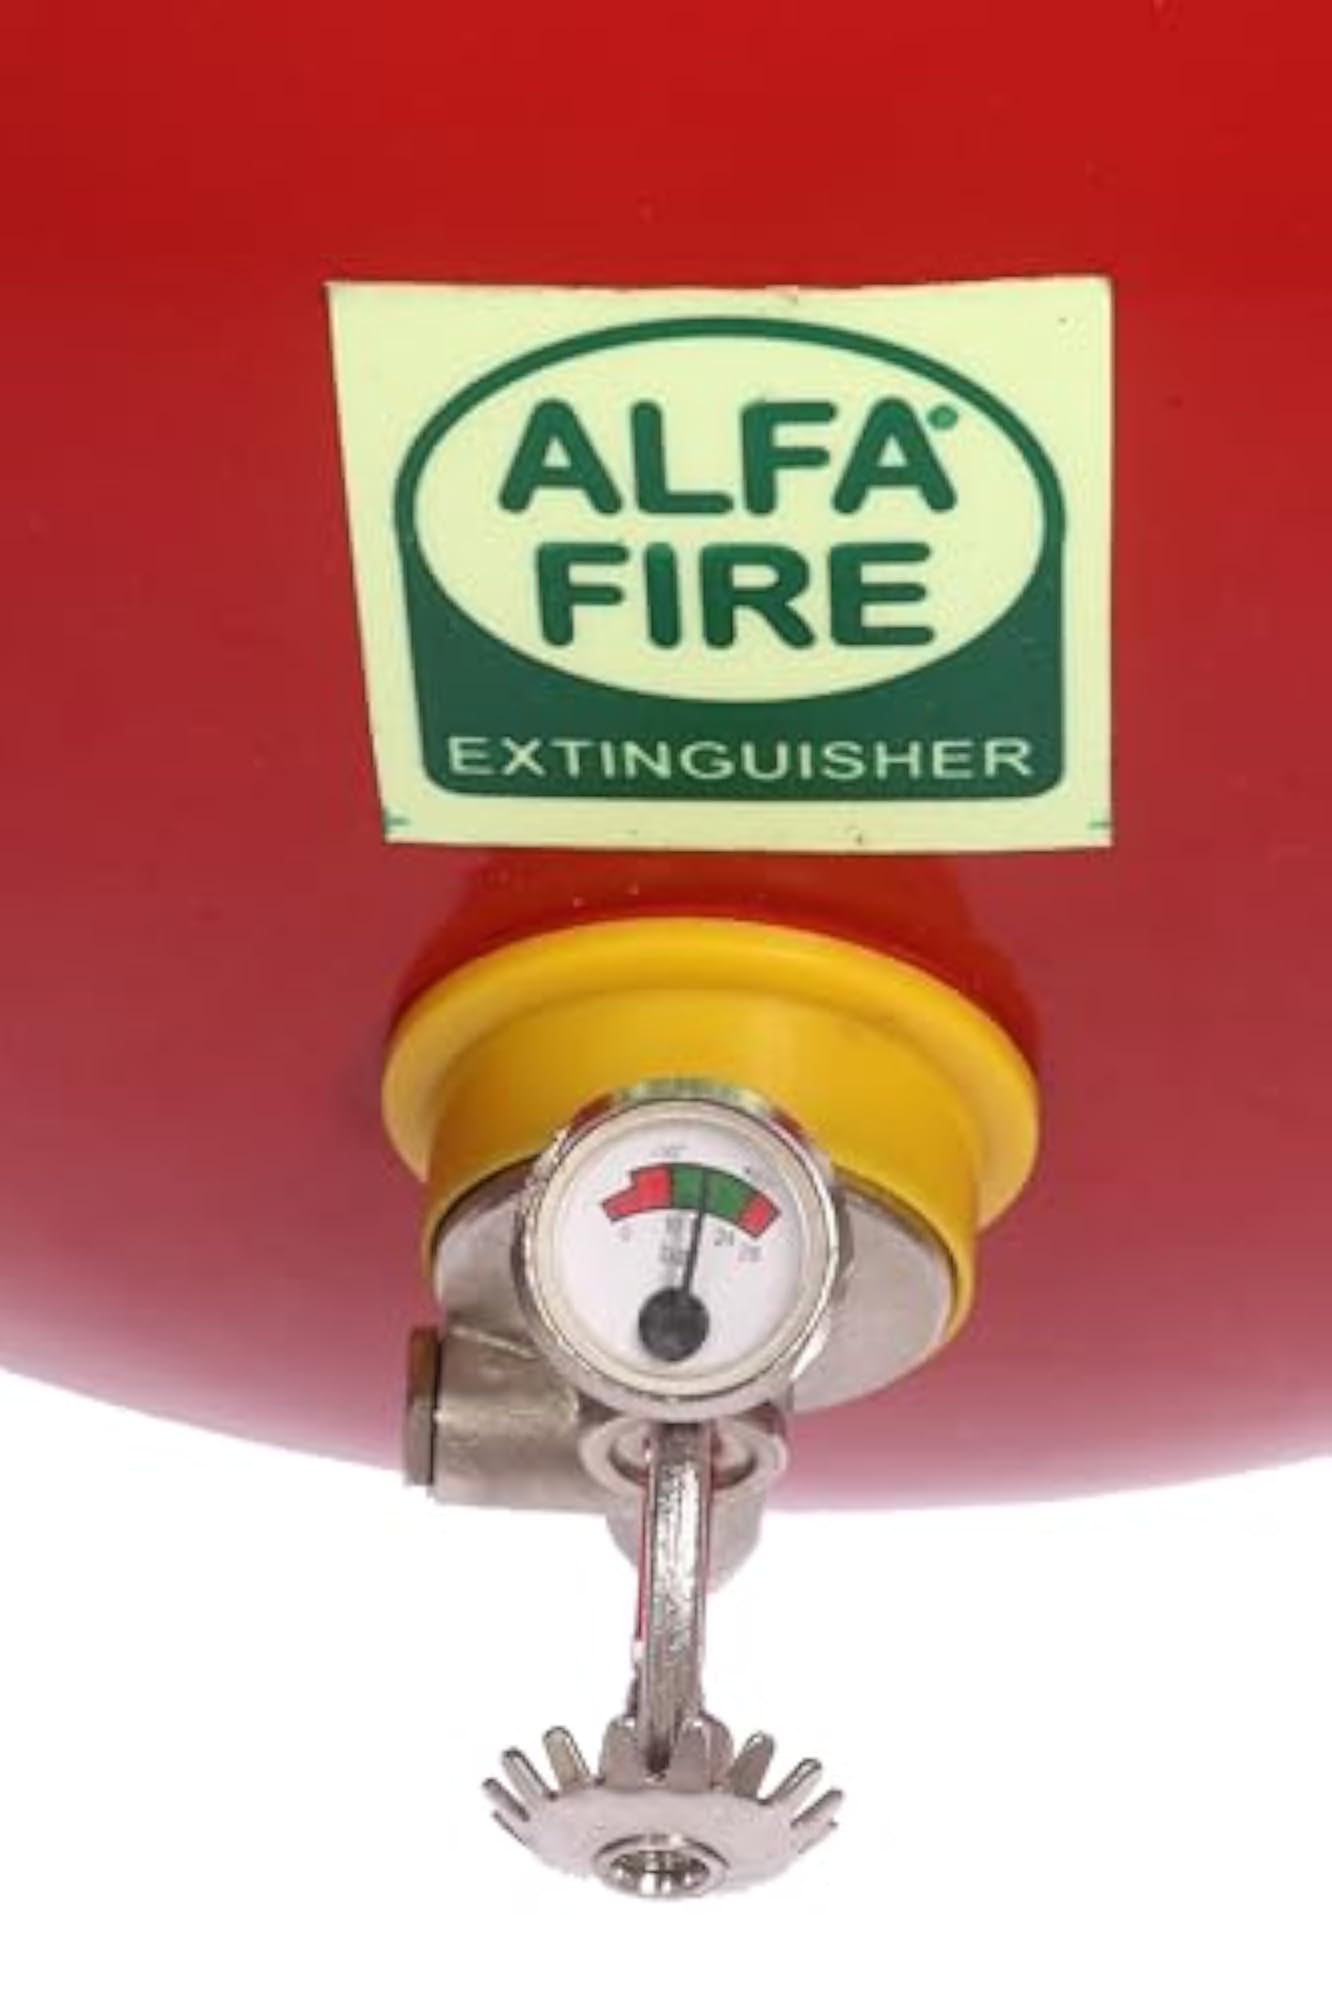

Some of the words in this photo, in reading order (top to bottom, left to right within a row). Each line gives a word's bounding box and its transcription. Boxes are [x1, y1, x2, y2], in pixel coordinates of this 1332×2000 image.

[498, 398, 957, 516] ALFA
[535, 541, 936, 649] FIRE
[448, 736, 1032, 780] EXTINGUISHER
